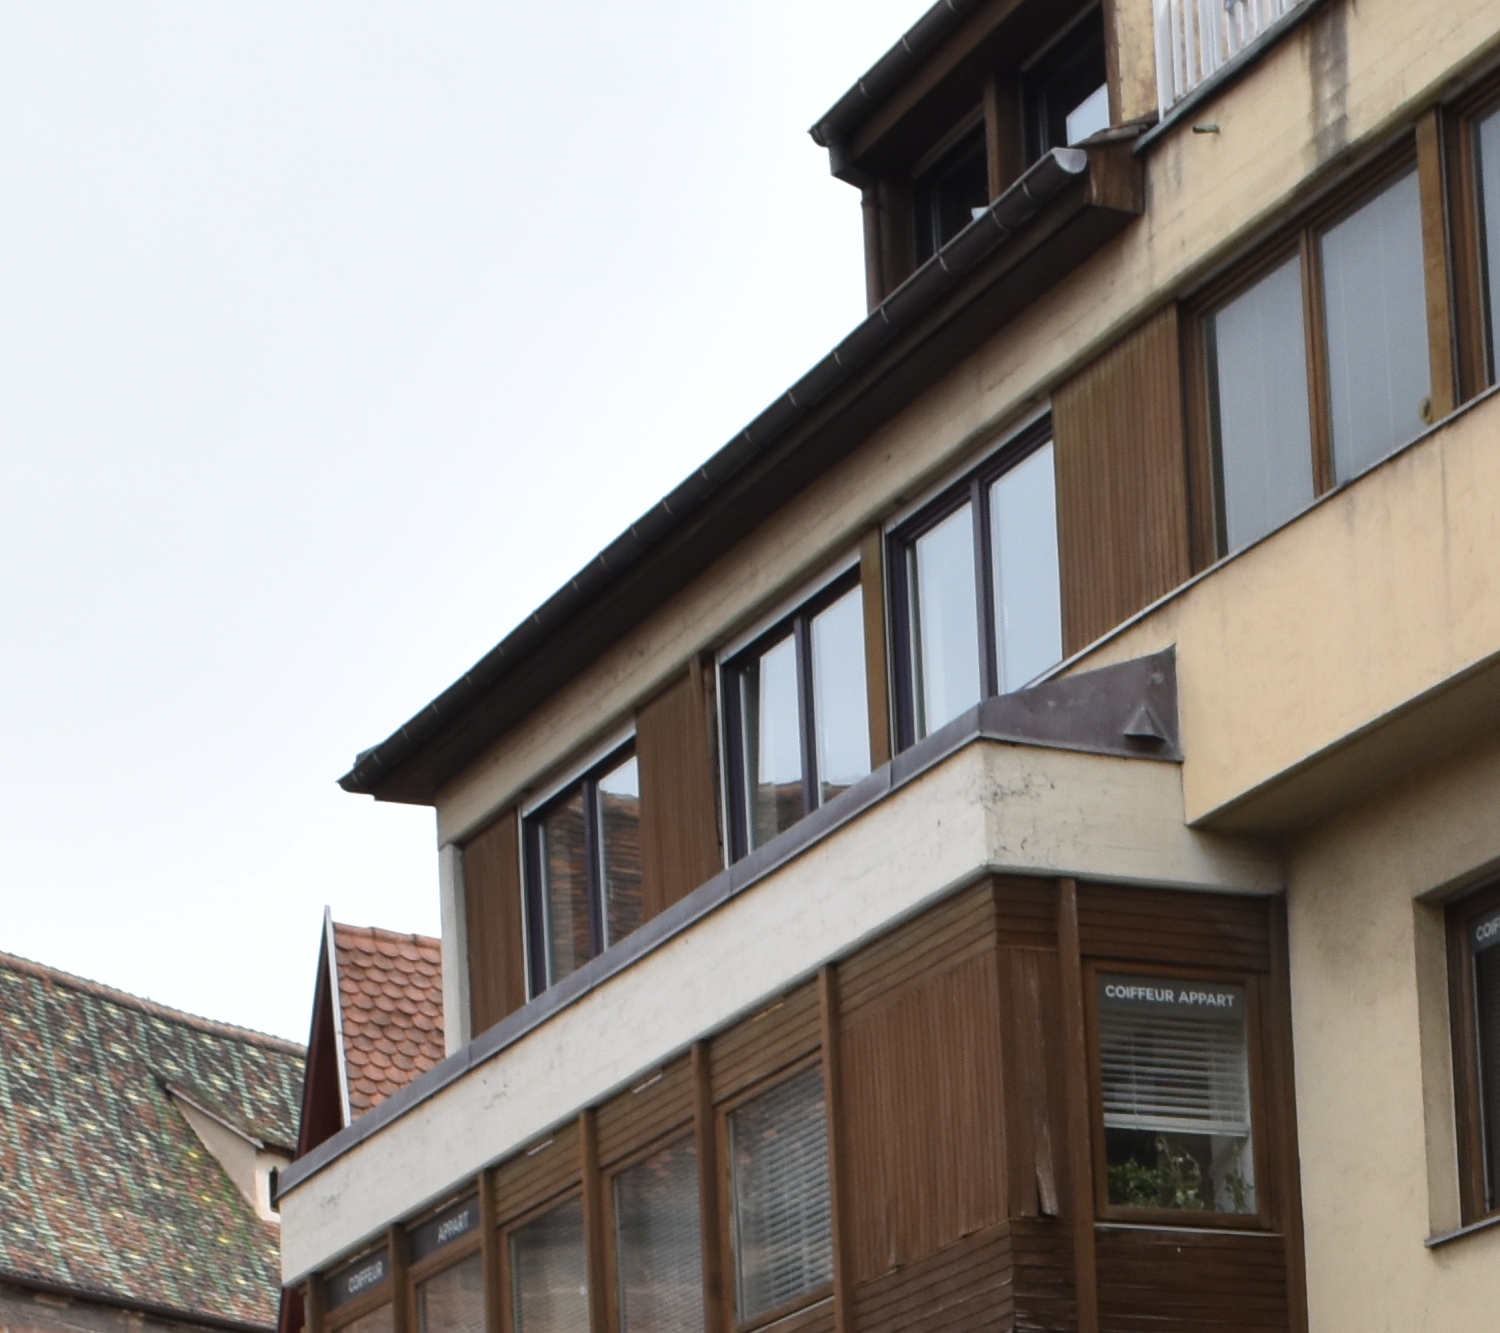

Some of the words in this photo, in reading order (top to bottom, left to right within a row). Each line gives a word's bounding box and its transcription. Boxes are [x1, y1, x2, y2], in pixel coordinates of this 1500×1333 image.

[1105, 984, 1174, 1003] COIFFEUR
[1178, 991, 1235, 1007] APPART
[348, 1261, 383, 1293] COIFFEUR
[437, 1211, 470, 1243] APPART
